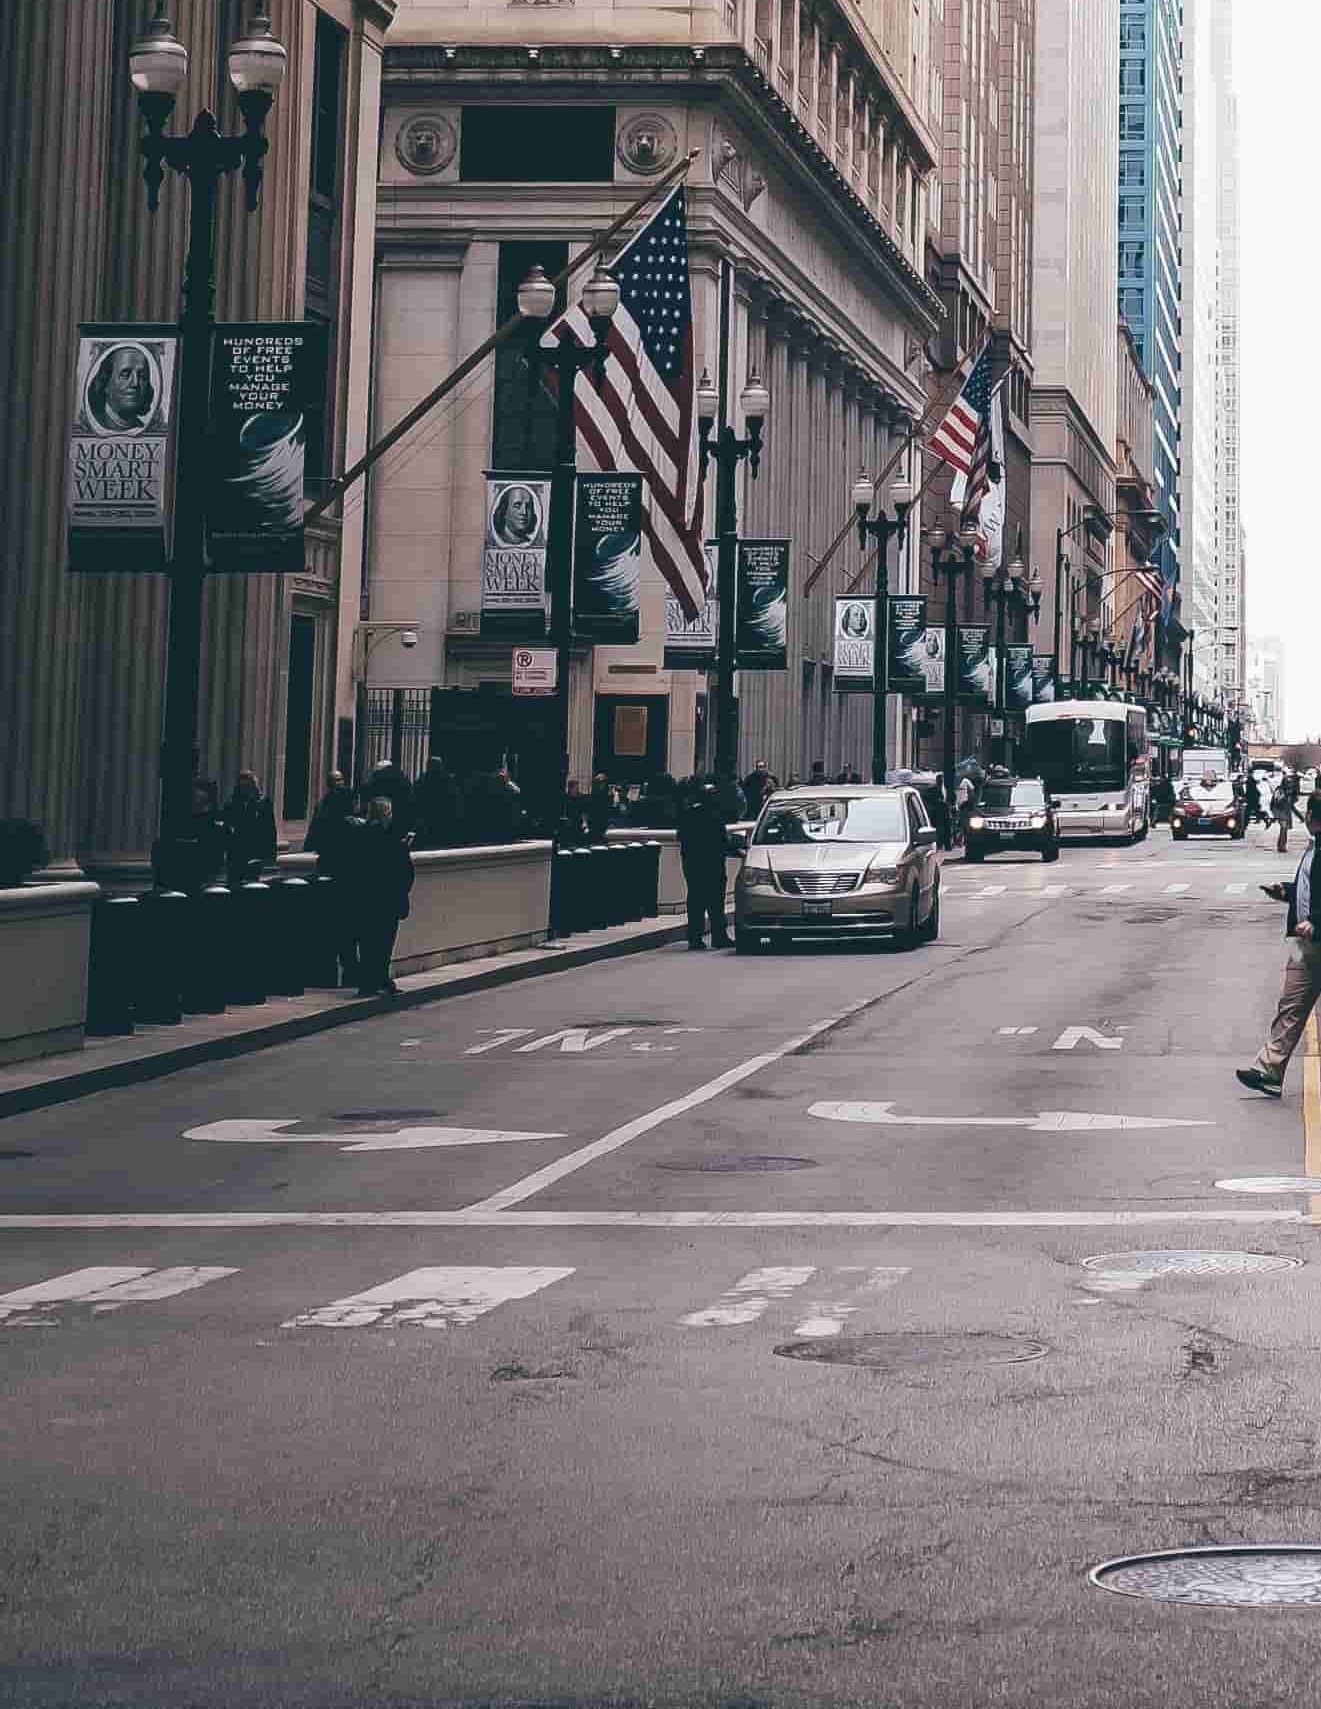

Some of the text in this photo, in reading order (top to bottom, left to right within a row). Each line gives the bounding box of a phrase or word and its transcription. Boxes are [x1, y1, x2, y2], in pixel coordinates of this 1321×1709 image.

[223, 337, 303, 346] HUNDREDS
[232, 346, 293, 355] OF FREE
[233, 355, 290, 364] EVENTS
[231, 364, 293, 373] TO HELP
[246, 374, 275, 382] YOU
[229, 383, 289, 391] MANAGE
[239, 392, 279, 401] YOUR
[232, 401, 284, 410] MONEY
[75, 442, 160, 459] MONEY
[73, 459, 159, 479] SMART
[73, 479, 158, 500] WEEK
[485, 552, 541, 565] MONEY
[485, 564, 540, 579] SMART
[485, 577, 541, 591] WEEK
